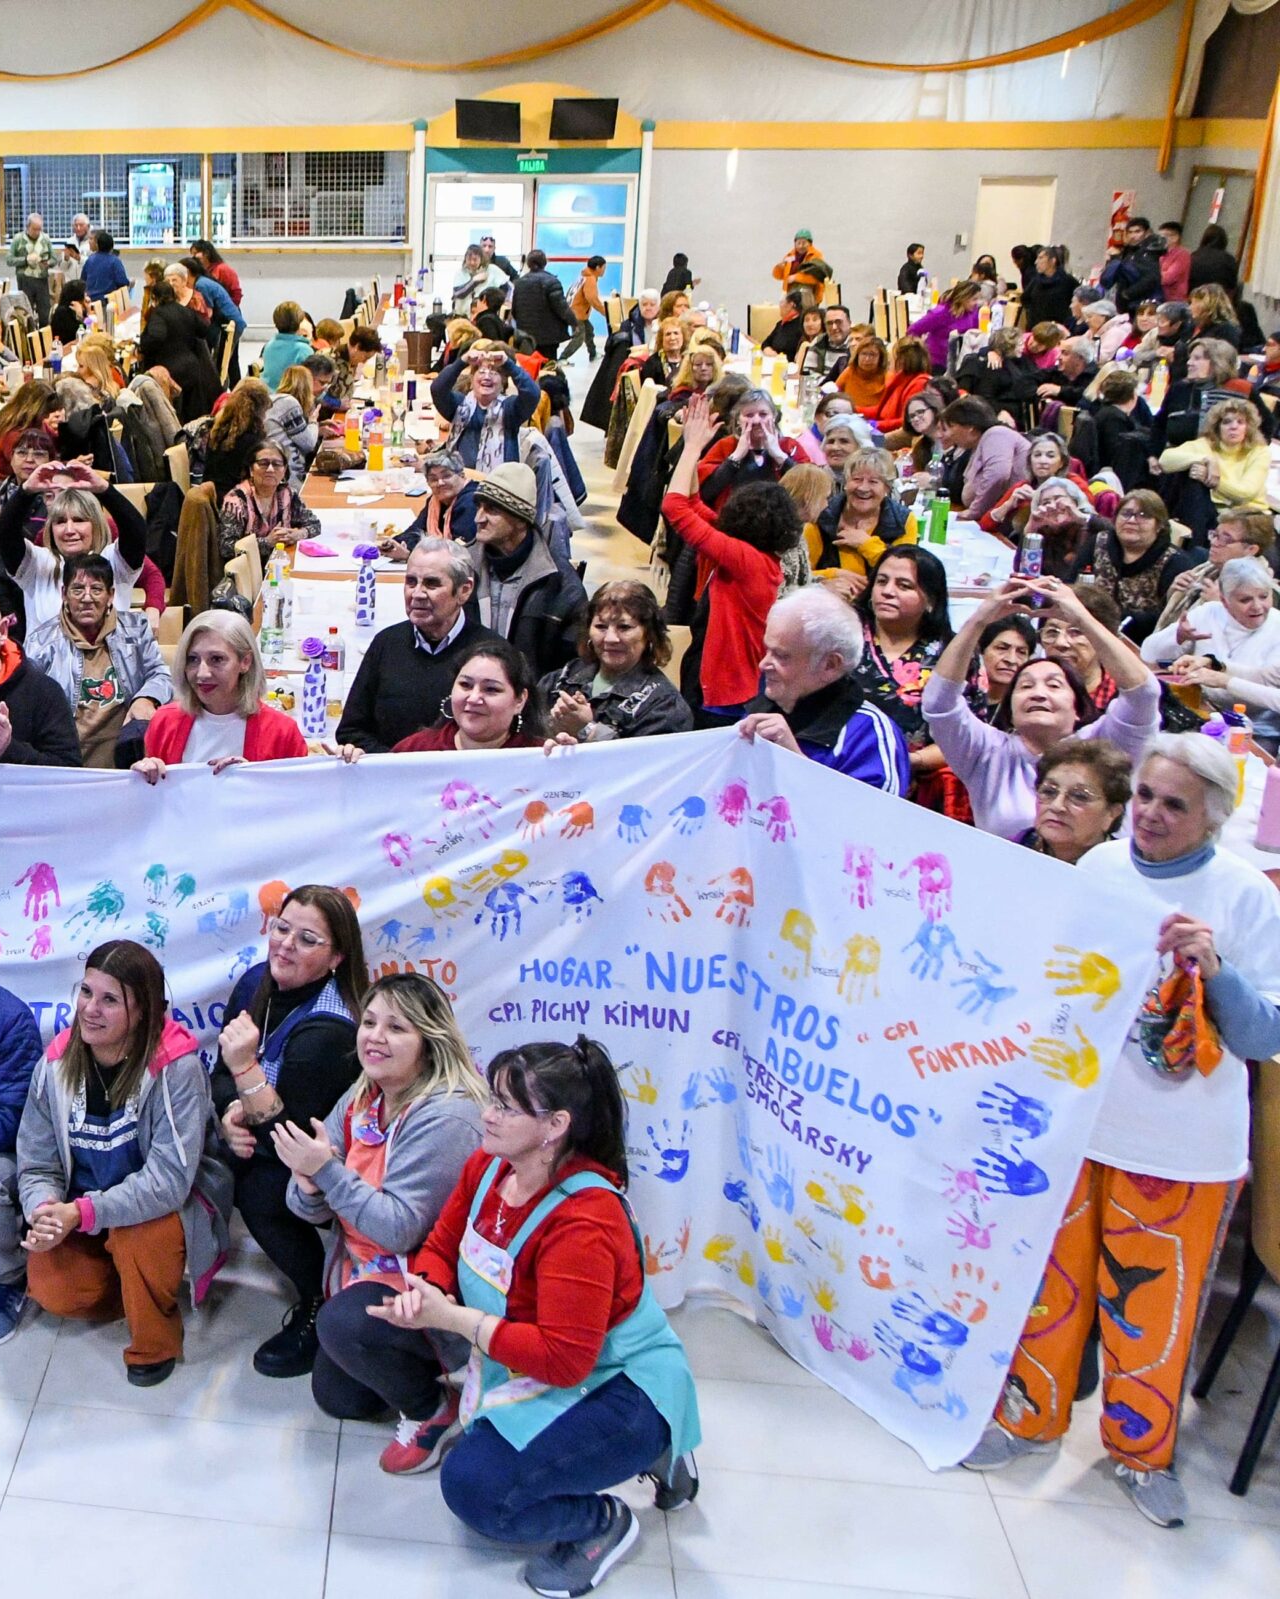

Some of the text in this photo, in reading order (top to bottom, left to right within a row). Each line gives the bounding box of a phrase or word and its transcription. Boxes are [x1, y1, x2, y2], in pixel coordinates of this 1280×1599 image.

[519, 956, 612, 990] HOGAR
[531, 998, 590, 1025] PICHY
[746, 1081, 873, 1174] SMOLARSKY
